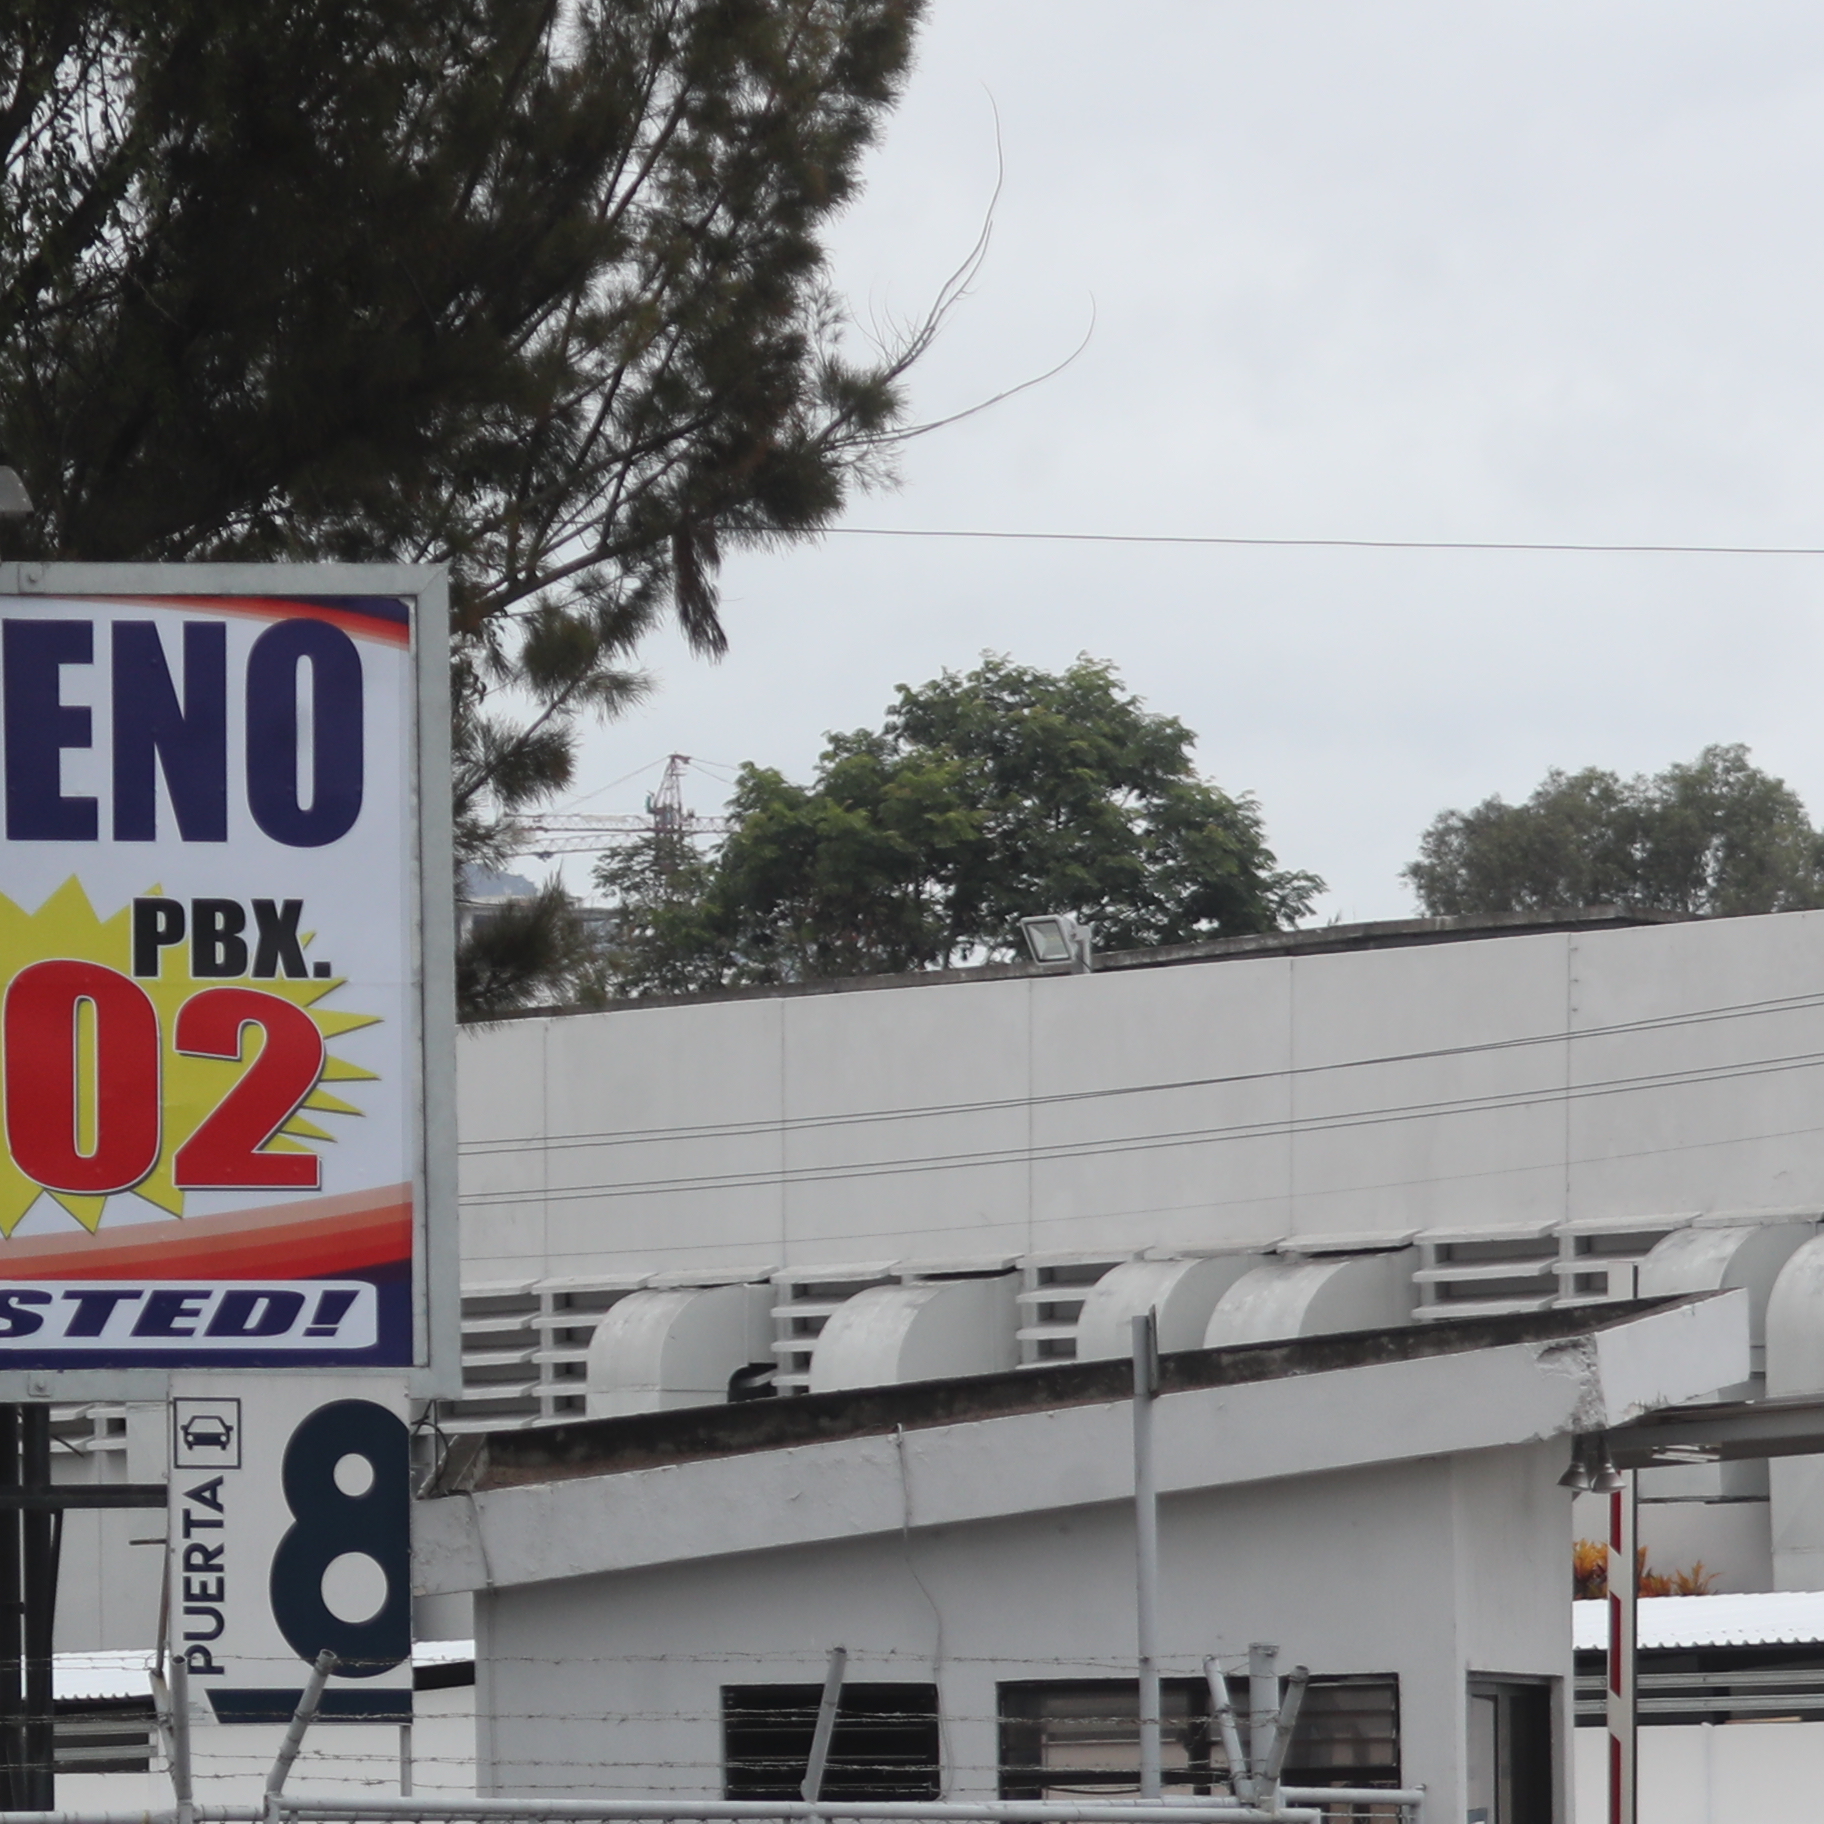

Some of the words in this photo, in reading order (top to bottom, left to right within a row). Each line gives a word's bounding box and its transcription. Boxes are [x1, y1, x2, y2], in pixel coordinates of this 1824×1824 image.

[0, 617, 364, 848] ENO
[131, 897, 333, 979] PBX.
[2, 958, 327, 1195] 02
[0, 1289, 361, 1338] STED!
[182, 1475, 225, 1676] PUERTA
[269, 1397, 412, 1680] 8
